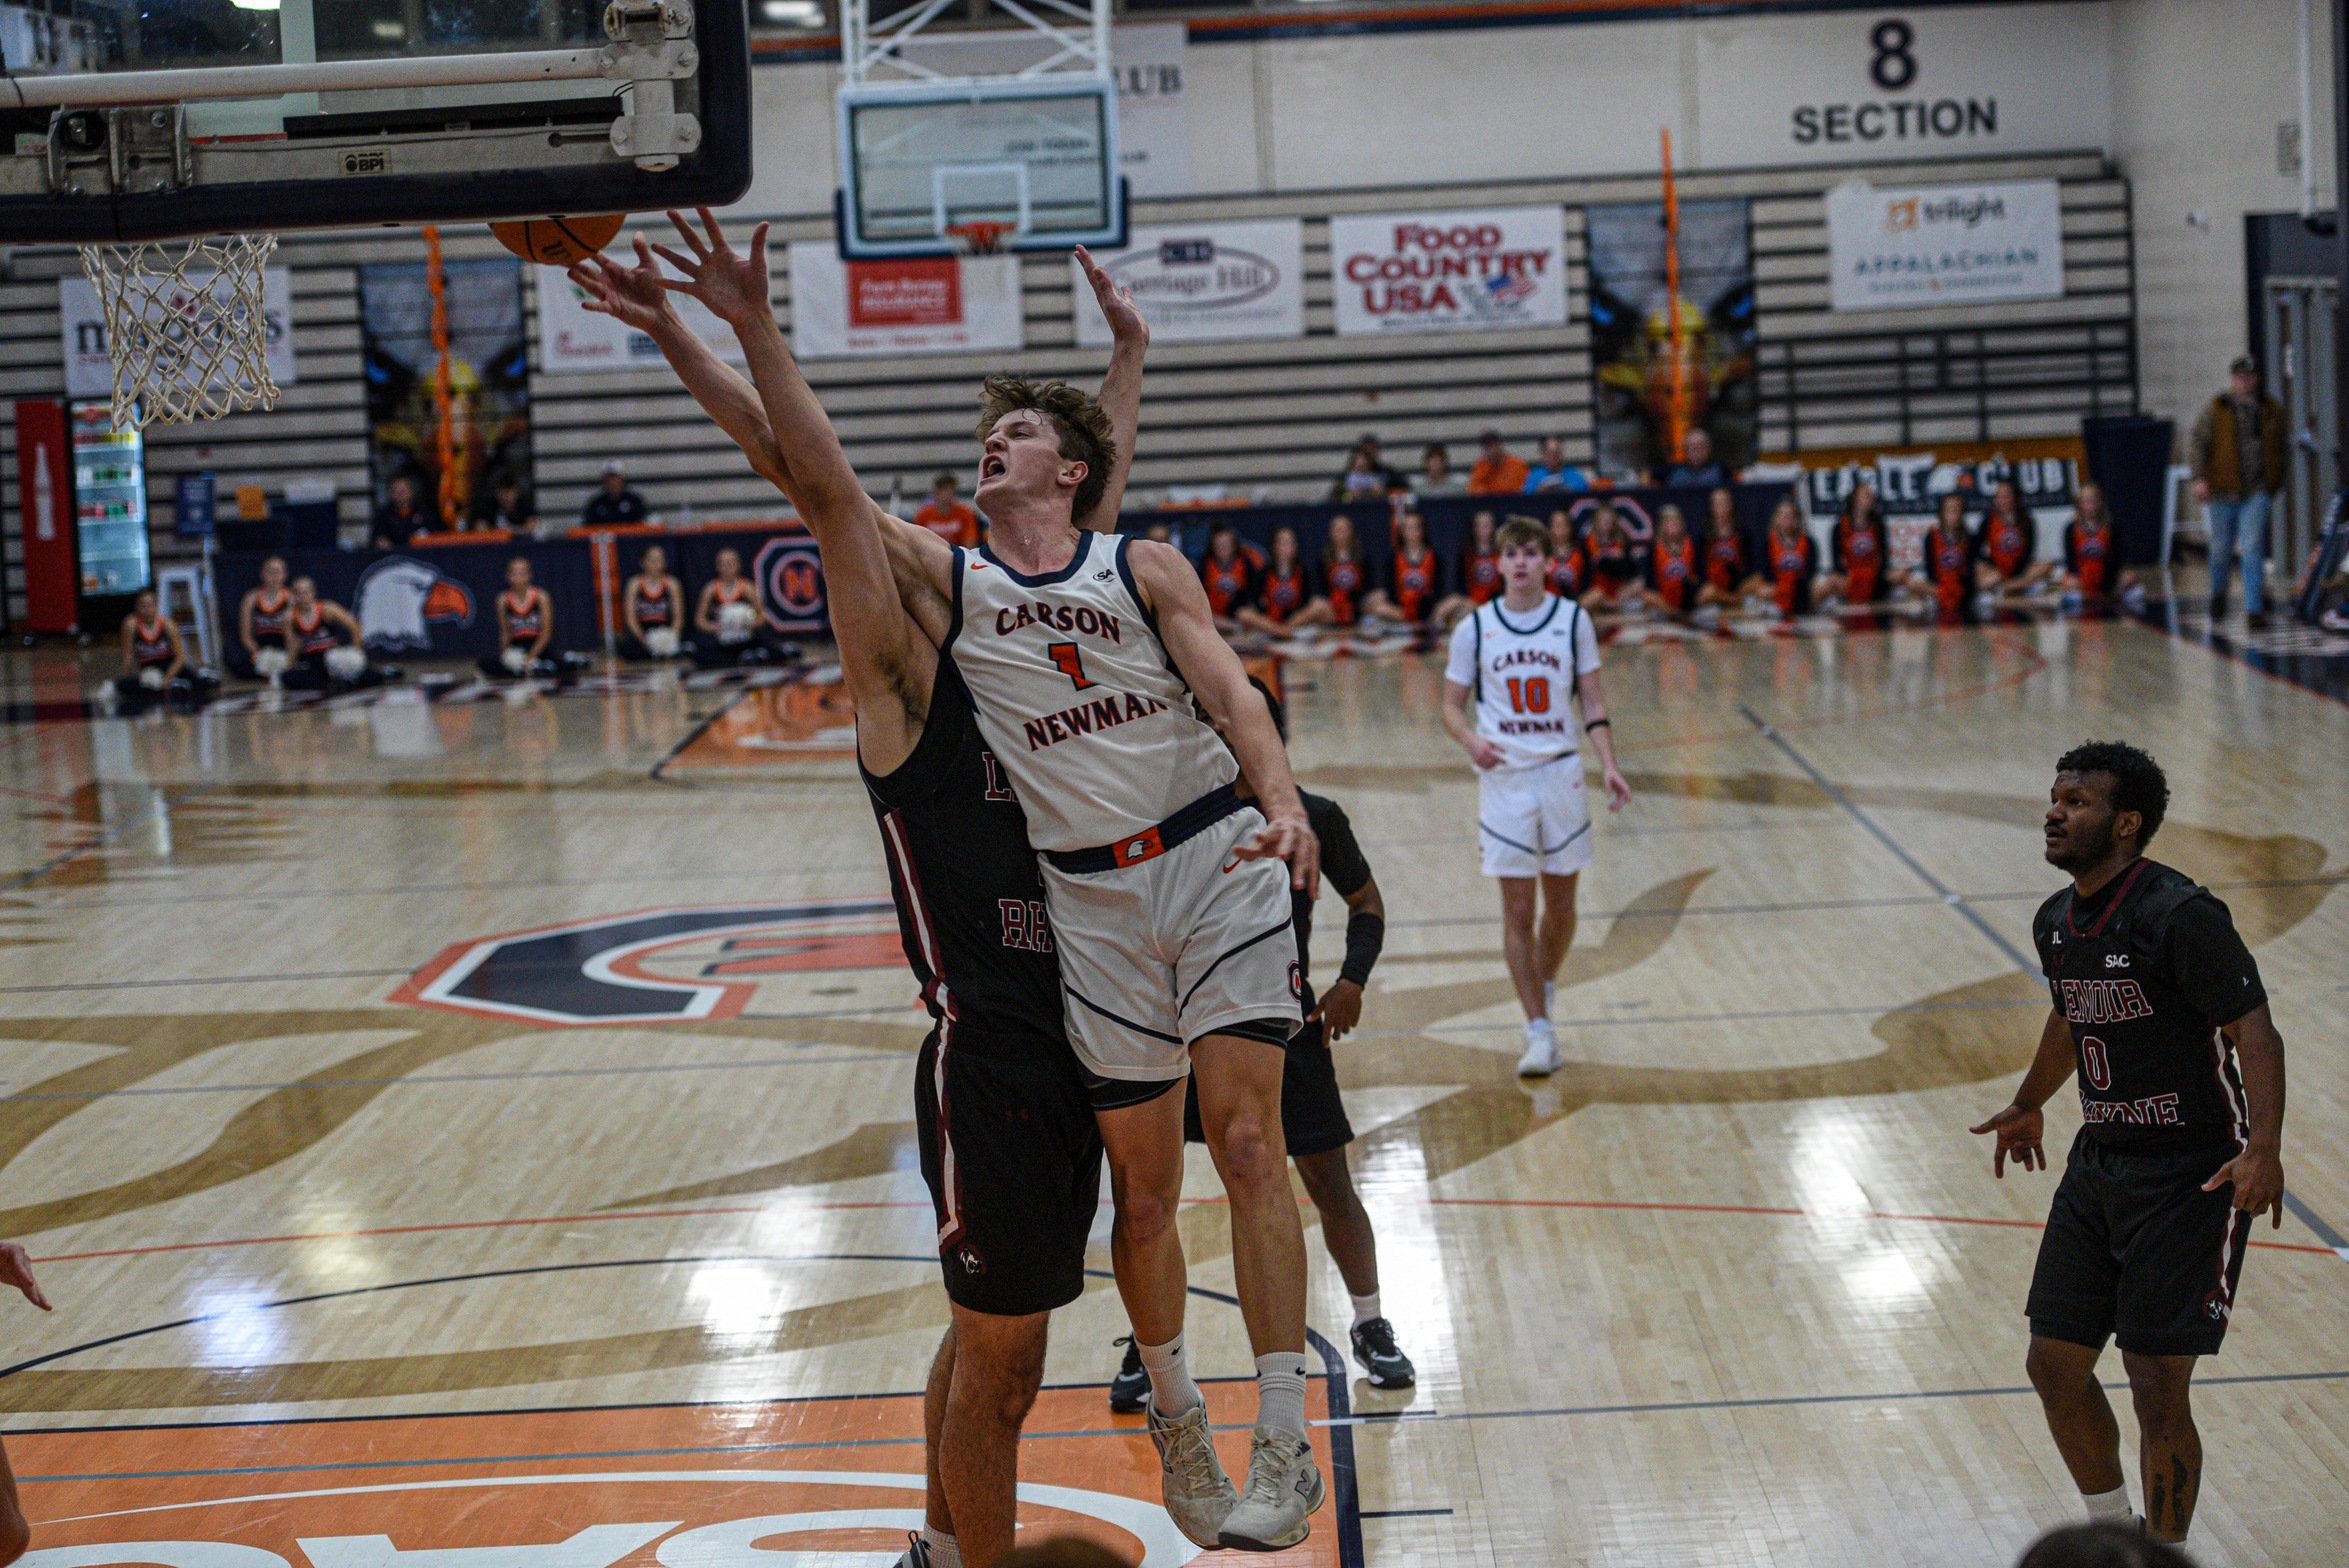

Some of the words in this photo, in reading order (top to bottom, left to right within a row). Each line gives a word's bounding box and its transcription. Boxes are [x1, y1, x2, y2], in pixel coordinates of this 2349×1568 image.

[1870, 18, 1917, 91] 8
[1793, 97, 1998, 144] SECTION
[1394, 224, 1502, 253] FOOD
[1346, 248, 1553, 284] COUNTRY
[1854, 247, 2040, 276] APPALACHIAN
[1364, 283, 1457, 315] USA
[995, 601, 1122, 645] CARSON
[1047, 641, 1101, 692] 1
[1493, 650, 1561, 672] CARSON
[1507, 677, 1550, 714] 10
[2105, 953, 2131, 969] SAC
[2053, 978, 2154, 1024] ENOIR
[2082, 1035, 2112, 1091] 0
